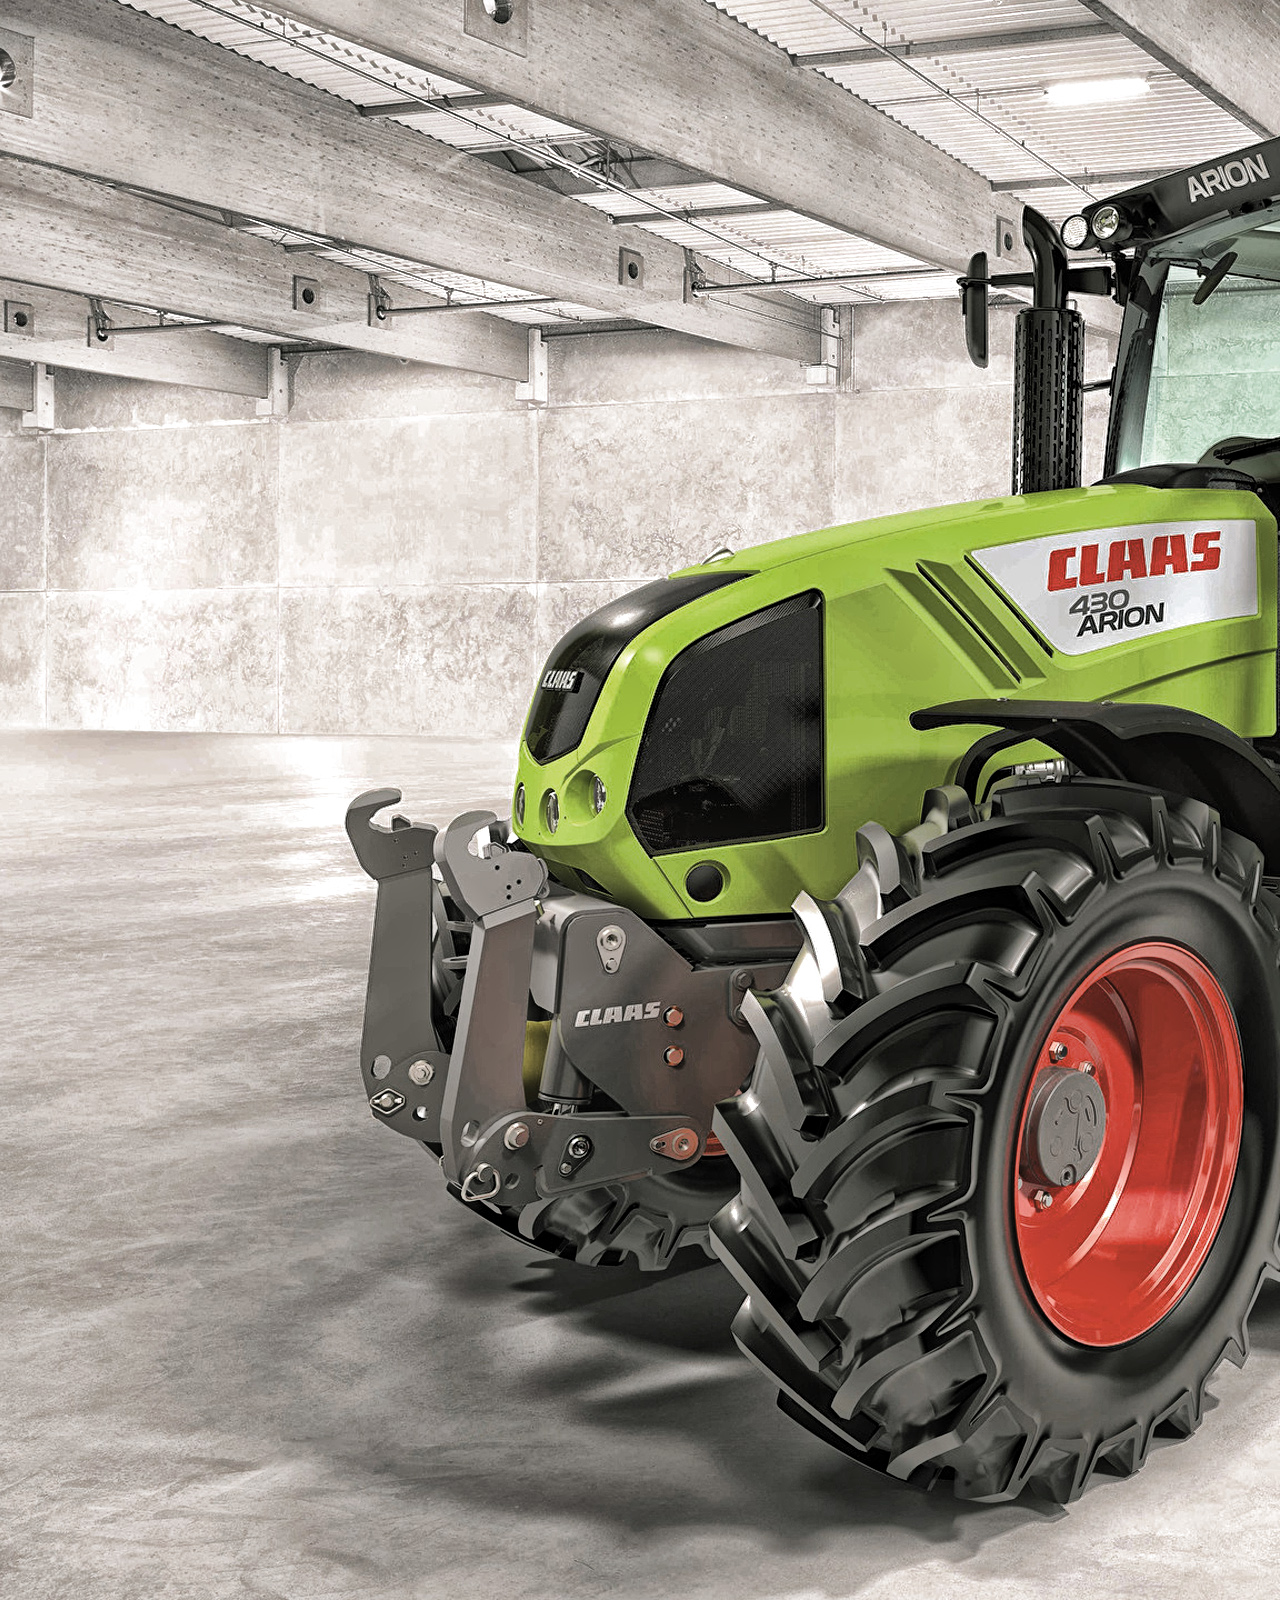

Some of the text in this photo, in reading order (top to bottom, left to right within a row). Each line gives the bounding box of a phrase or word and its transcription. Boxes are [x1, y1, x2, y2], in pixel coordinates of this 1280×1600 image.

[1187, 153, 1270, 203] ARION
[1047, 530, 1221, 592] CLAAS
[1069, 588, 1129, 615] 430
[1076, 602, 1165, 637] ARION
[542, 670, 578, 689] CLAAS
[574, 1001, 661, 1028] CLAAS
